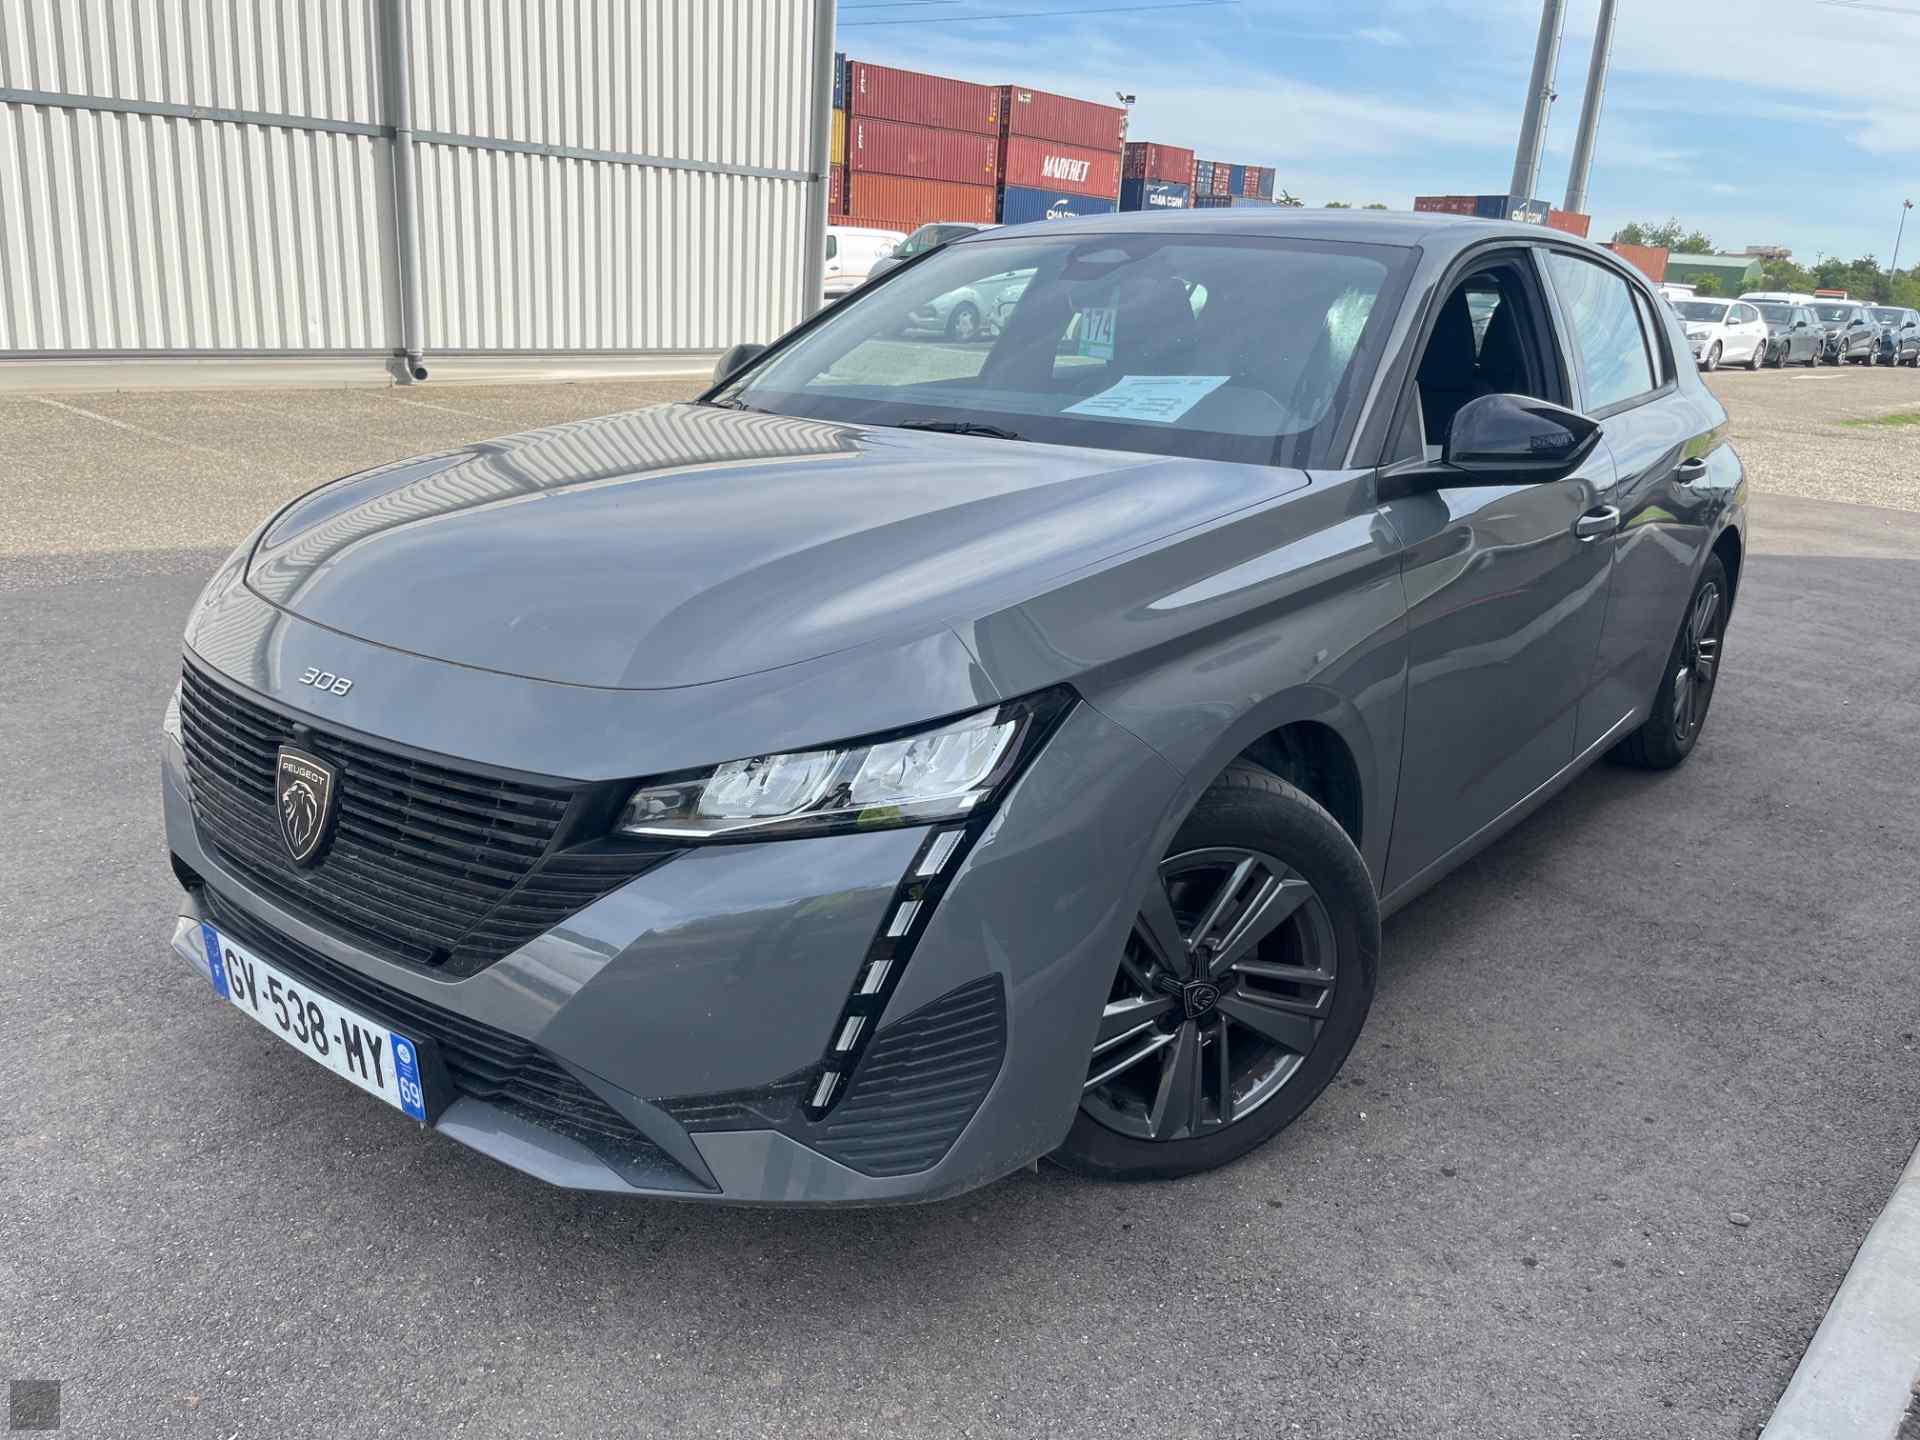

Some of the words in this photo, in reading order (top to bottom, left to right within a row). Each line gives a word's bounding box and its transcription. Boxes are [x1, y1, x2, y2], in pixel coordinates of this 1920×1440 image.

[299, 667, 353, 696] 308
[282, 761, 325, 785] PEUGEOT
[225, 948, 384, 1089] GV-538-MY
[400, 1077, 421, 1108] 69
